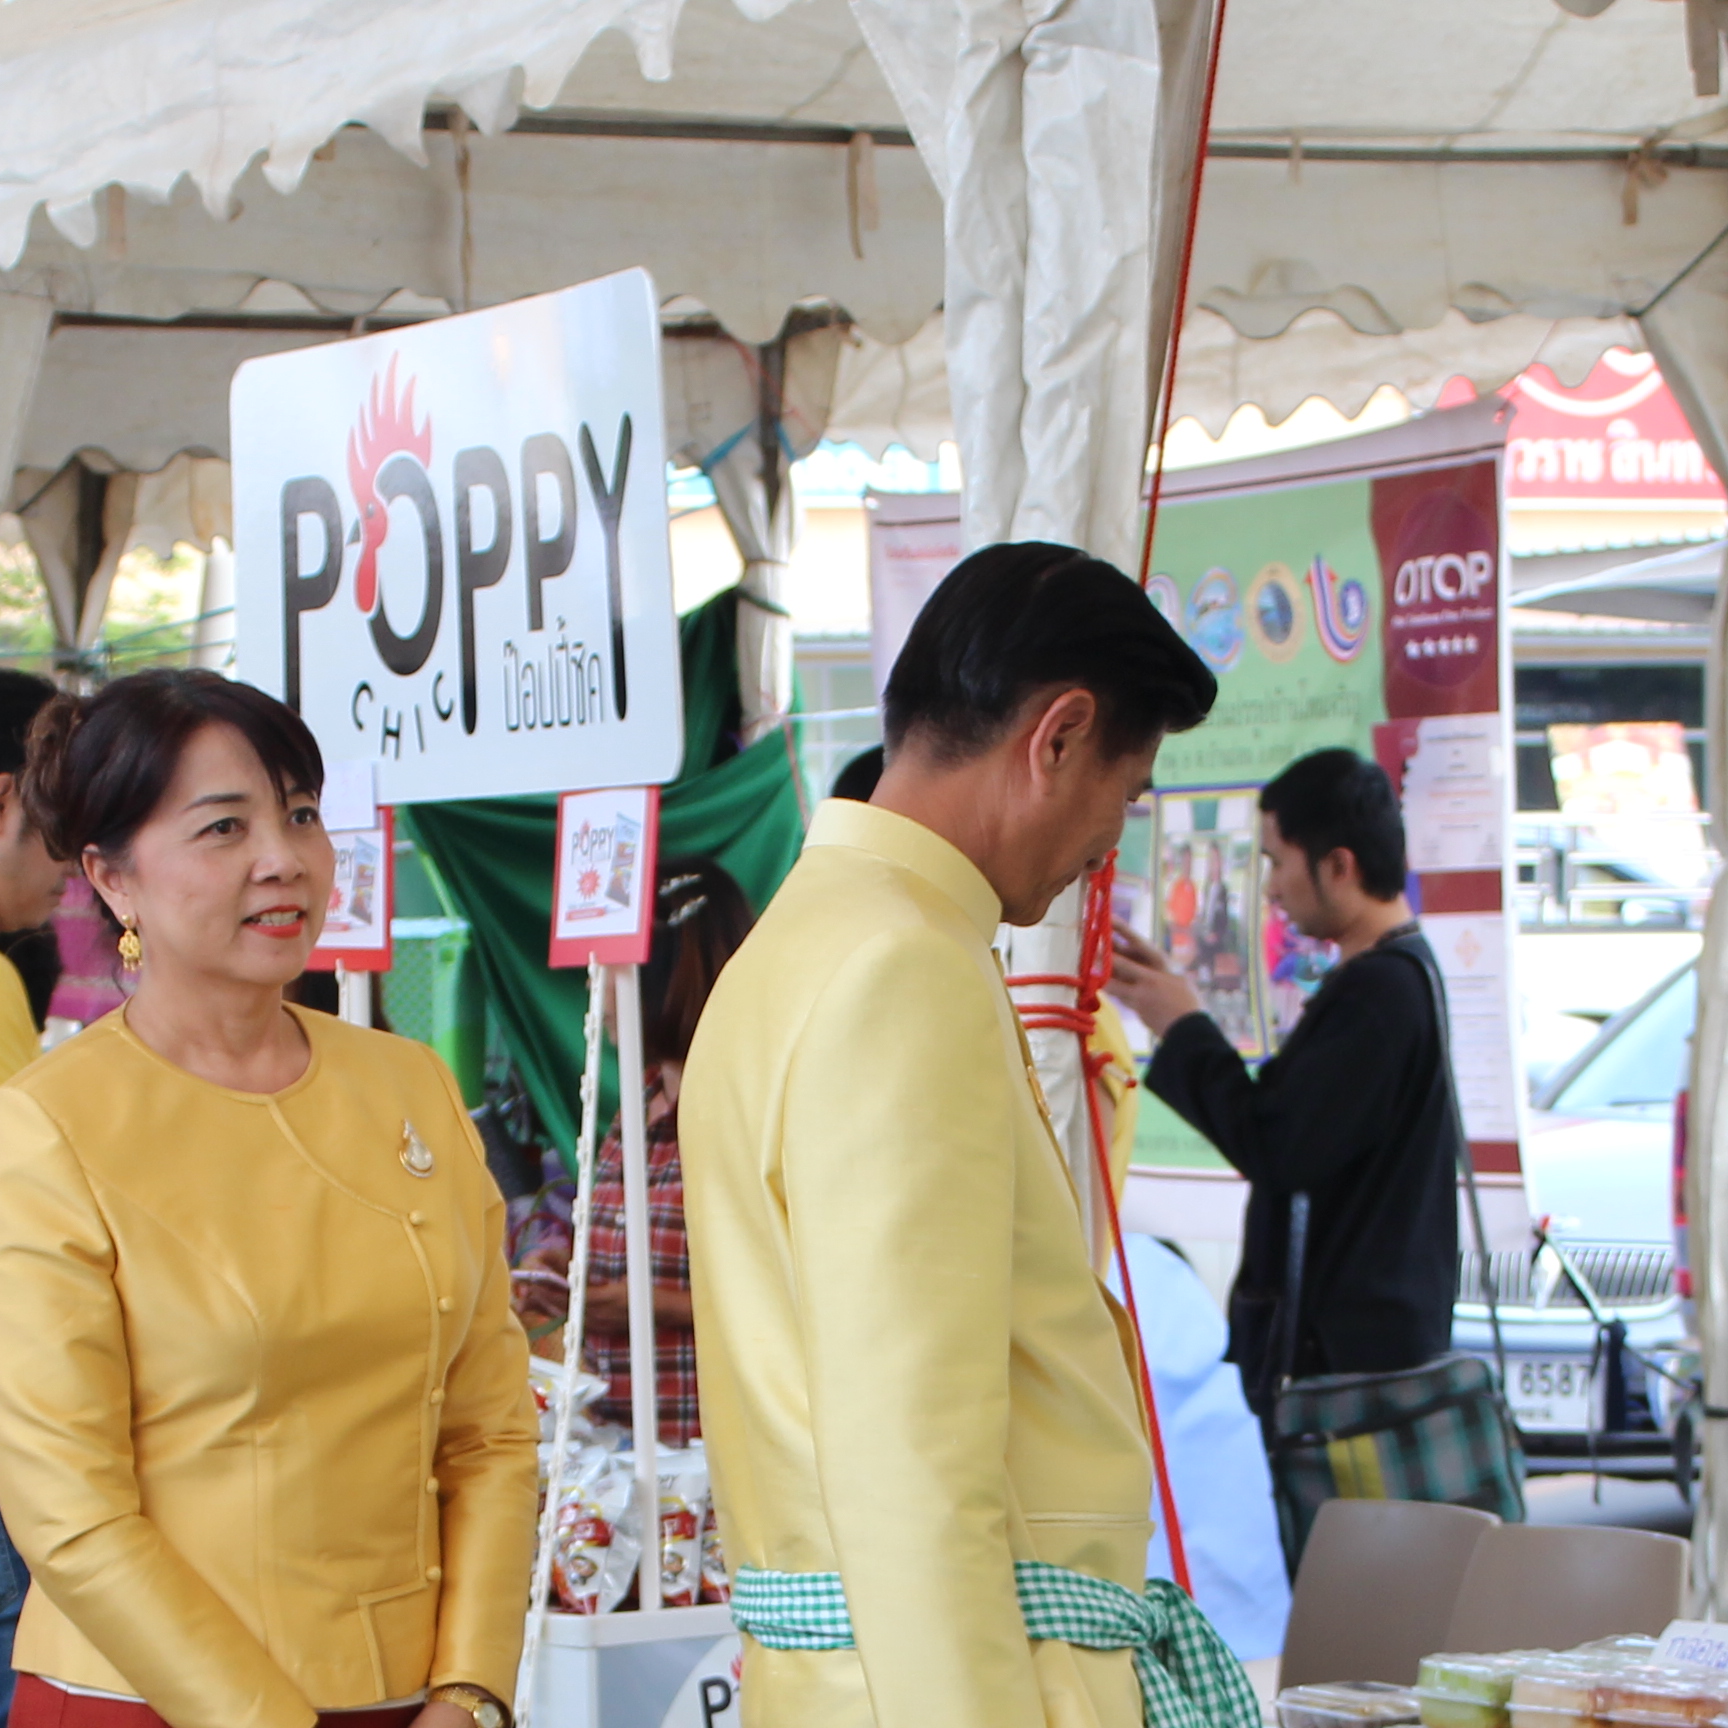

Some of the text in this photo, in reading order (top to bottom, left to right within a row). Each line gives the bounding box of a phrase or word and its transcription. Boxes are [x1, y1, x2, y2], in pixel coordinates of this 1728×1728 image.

[279, 411, 634, 736] POPPY
[1393, 549, 1493, 607] OTOP
[352, 670, 454, 760] CHIC
